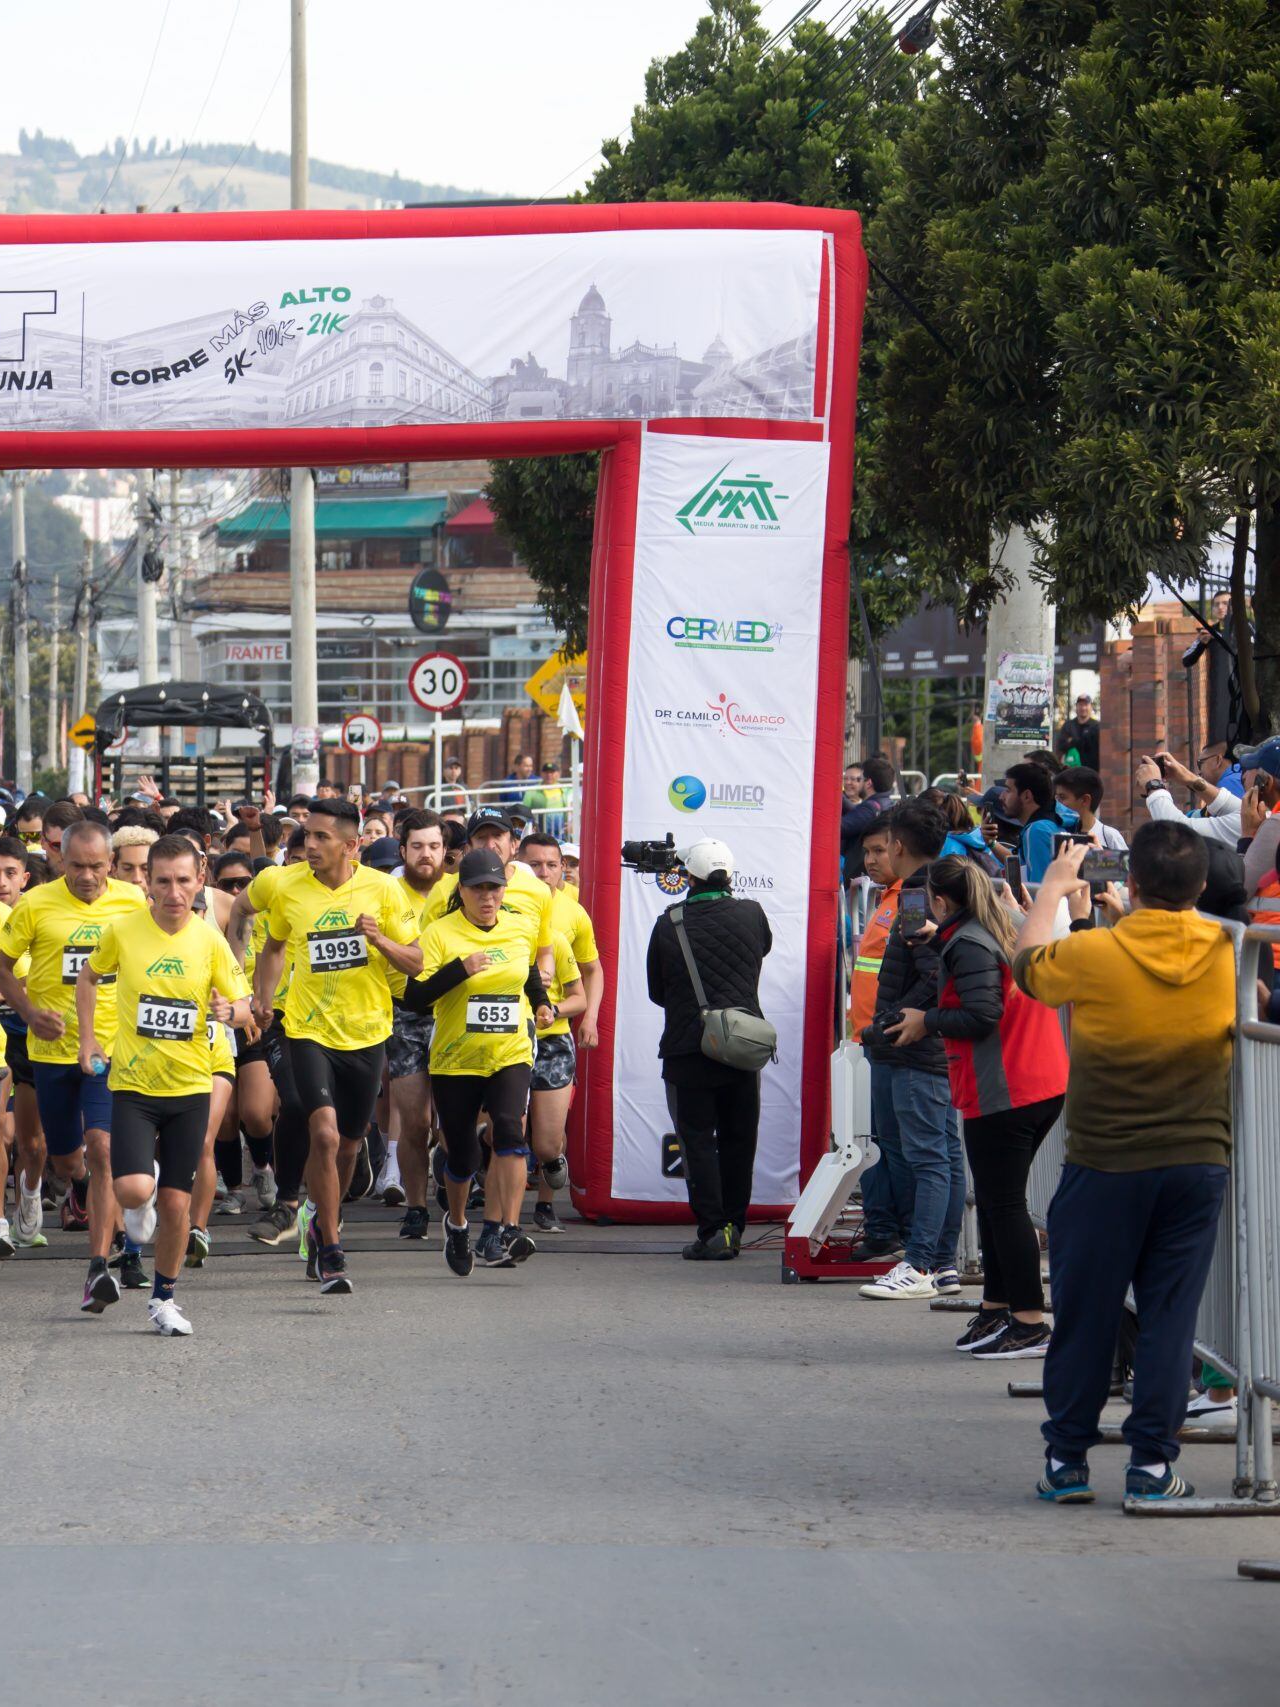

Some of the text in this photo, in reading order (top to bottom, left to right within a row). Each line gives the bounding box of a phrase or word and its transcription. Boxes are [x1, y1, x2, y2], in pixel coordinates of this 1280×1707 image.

[110, 286, 352, 386] CORRE MÁS ALTO
[422, 668, 457, 695] 30
[655, 709, 672, 719] DR
[677, 710, 721, 721] CAMILO
[710, 783, 765, 806] LIMEQ
[314, 939, 362, 961] 1993
[142, 1008, 191, 1030] 1841
[477, 1005, 511, 1023] 653
